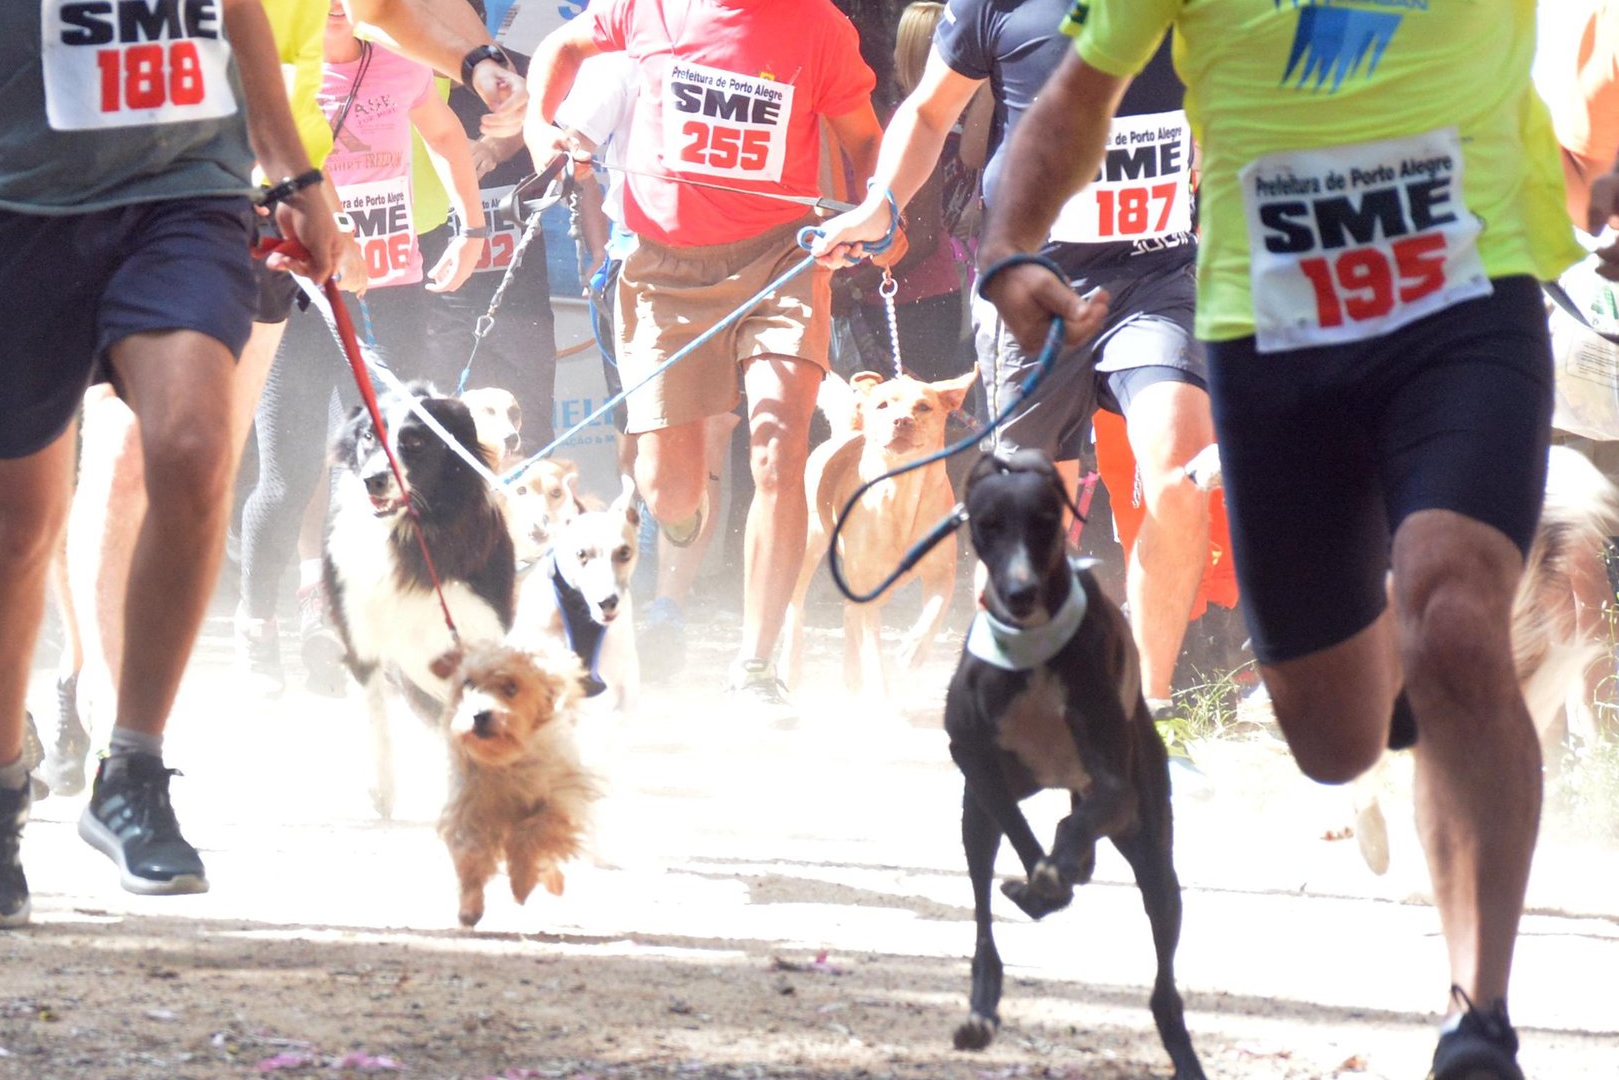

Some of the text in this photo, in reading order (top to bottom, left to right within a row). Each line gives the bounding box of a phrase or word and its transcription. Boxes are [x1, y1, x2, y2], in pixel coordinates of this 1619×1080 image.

[97, 41, 205, 112] 188
[671, 66, 782, 102] Prefeitura de Porto Alegre
[671, 81, 781, 125] SME
[680, 121, 771, 171] 255
[1115, 133, 1127, 145] de
[1130, 130, 1155, 144] Porto
[1093, 140, 1181, 182] ME
[1255, 155, 1453, 197] Prefeitura de Porto Alegre
[347, 204, 410, 238] ME
[354, 196, 364, 208] de
[366, 193, 386, 207] Porto
[1096, 182, 1177, 237] 187
[1259, 176, 1459, 254] SME
[356, 233, 411, 279] 06
[1299, 232, 1447, 328] 195
